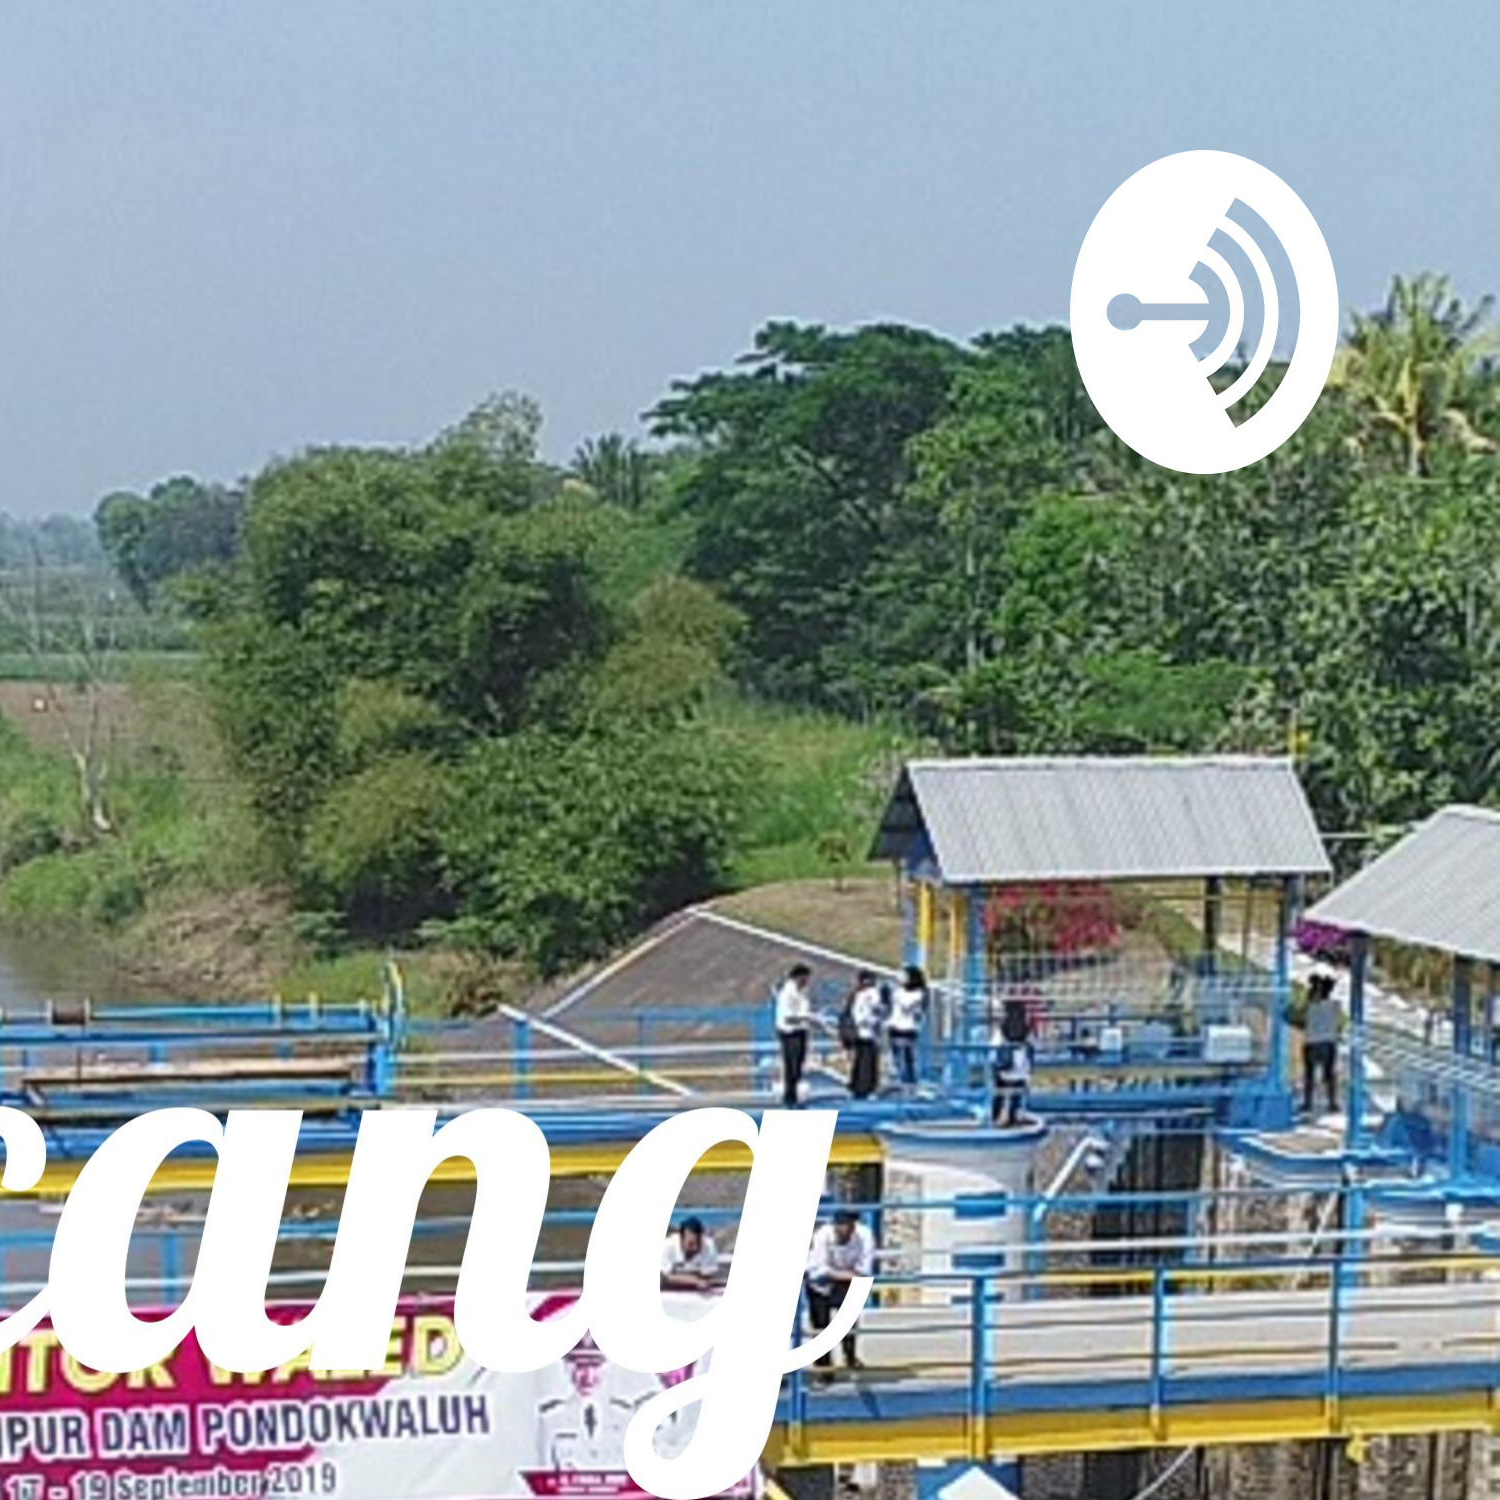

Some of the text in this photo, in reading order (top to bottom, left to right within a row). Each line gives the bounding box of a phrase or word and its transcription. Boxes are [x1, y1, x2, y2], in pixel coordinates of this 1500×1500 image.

[98, 1406, 188, 1458] DAM
[199, 1394, 491, 1451] PONDOKWALUH
[265, 1461, 337, 1496] 2019
